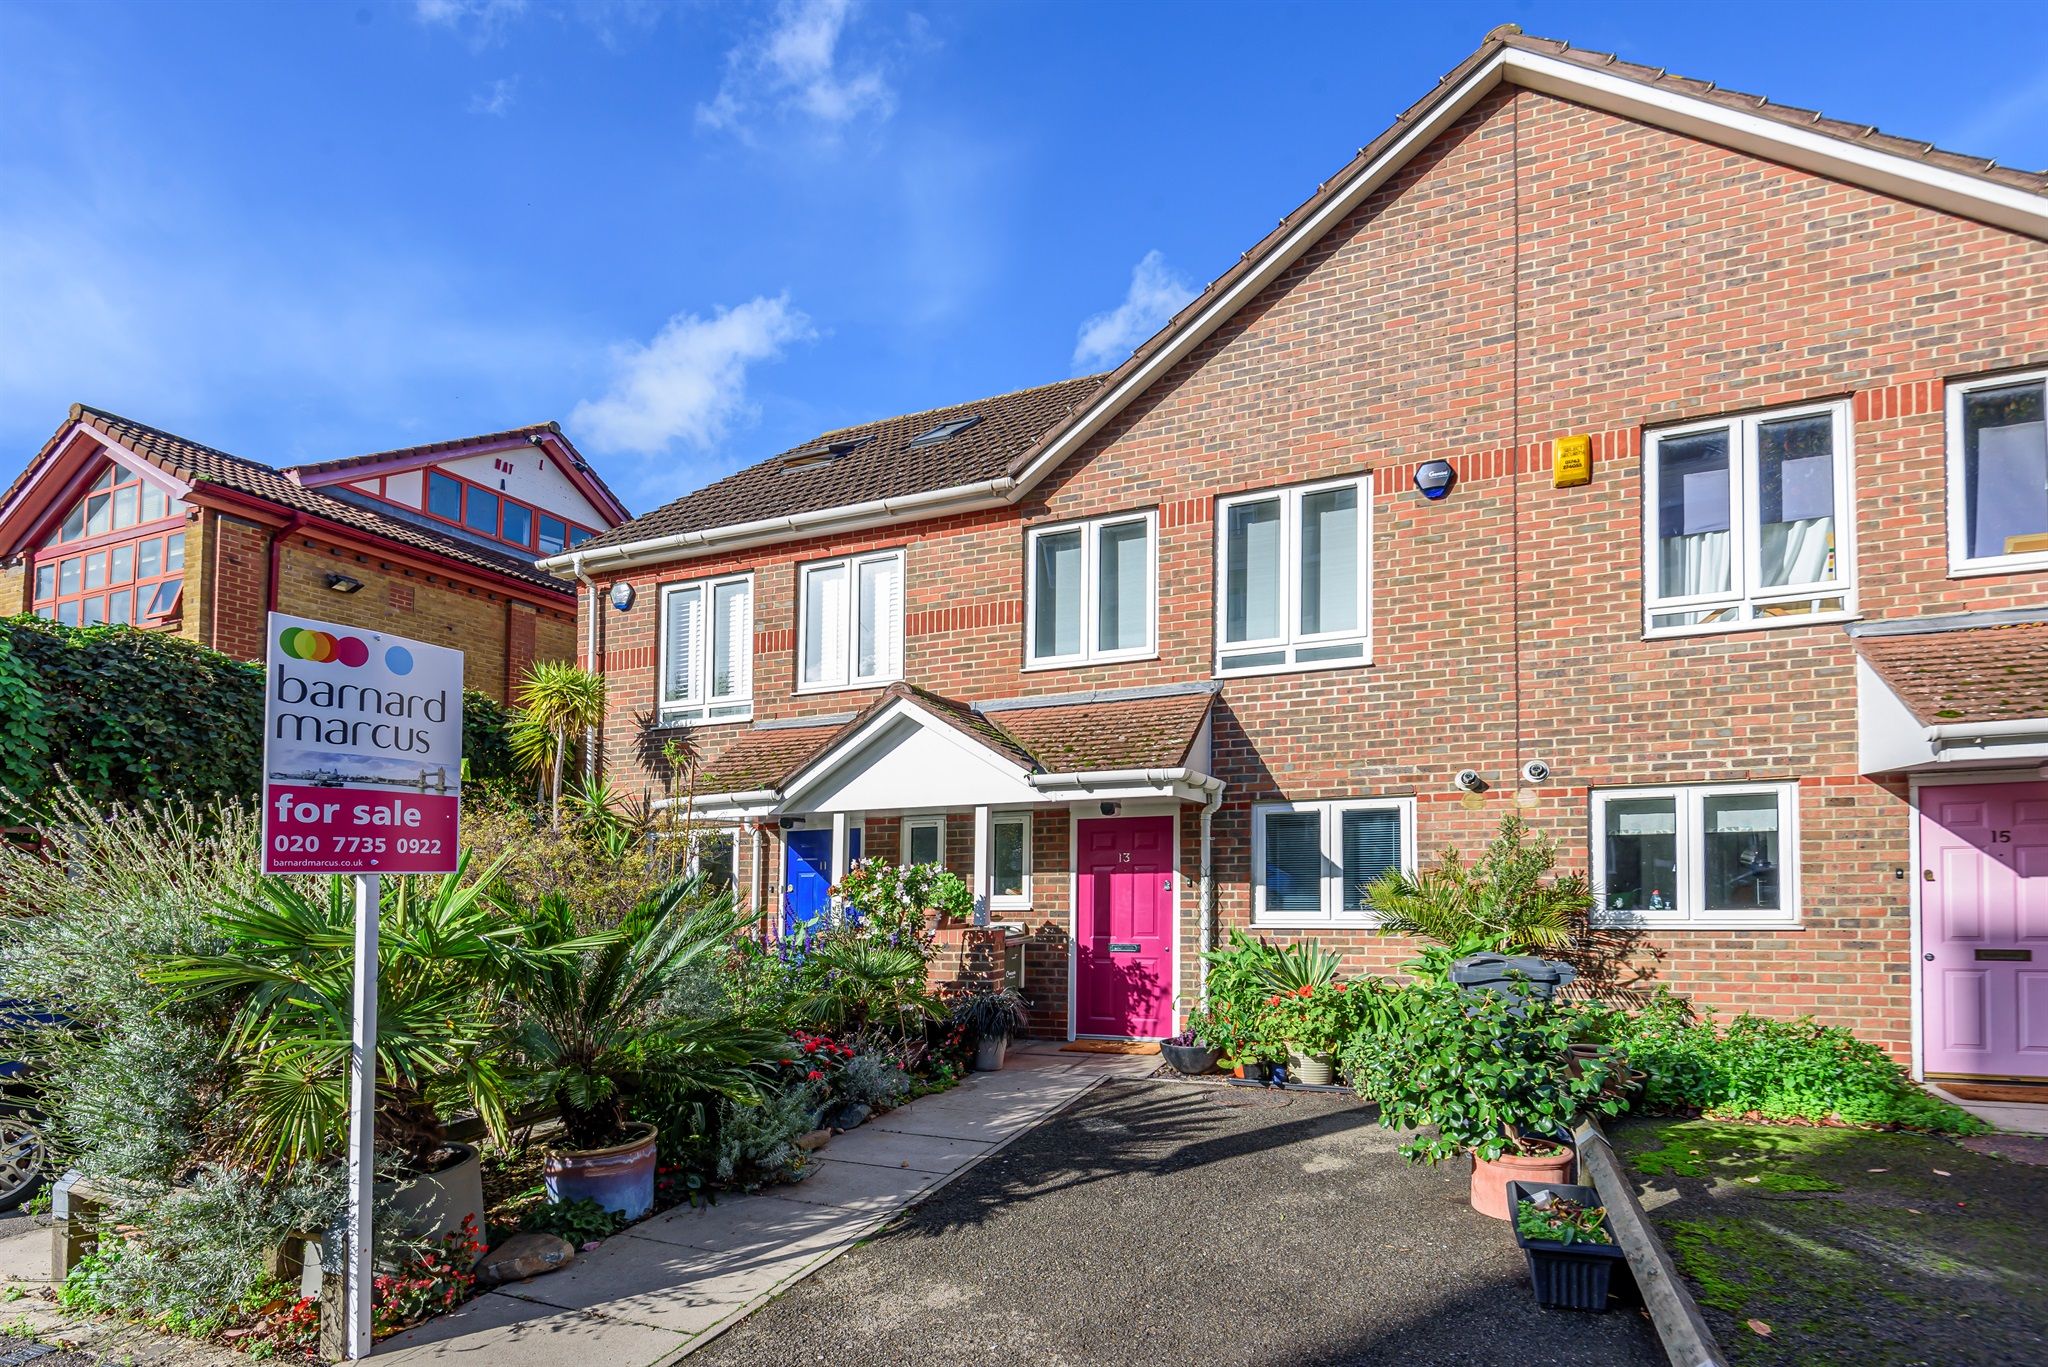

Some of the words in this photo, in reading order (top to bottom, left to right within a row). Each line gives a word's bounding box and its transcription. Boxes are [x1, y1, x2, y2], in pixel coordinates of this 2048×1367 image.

[277, 664, 446, 722] barnard
[276, 713, 430, 753] marcus
[274, 793, 341, 824] for
[353, 799, 422, 827] sale
[274, 834, 320, 852] 020
[332, 836, 387, 853] 7735
[396, 838, 442, 854] 0922
[1991, 830, 2012, 843] 15
[273, 858, 363, 867] barnardmarcus.co.uk
[1119, 852, 1131, 863] 13
